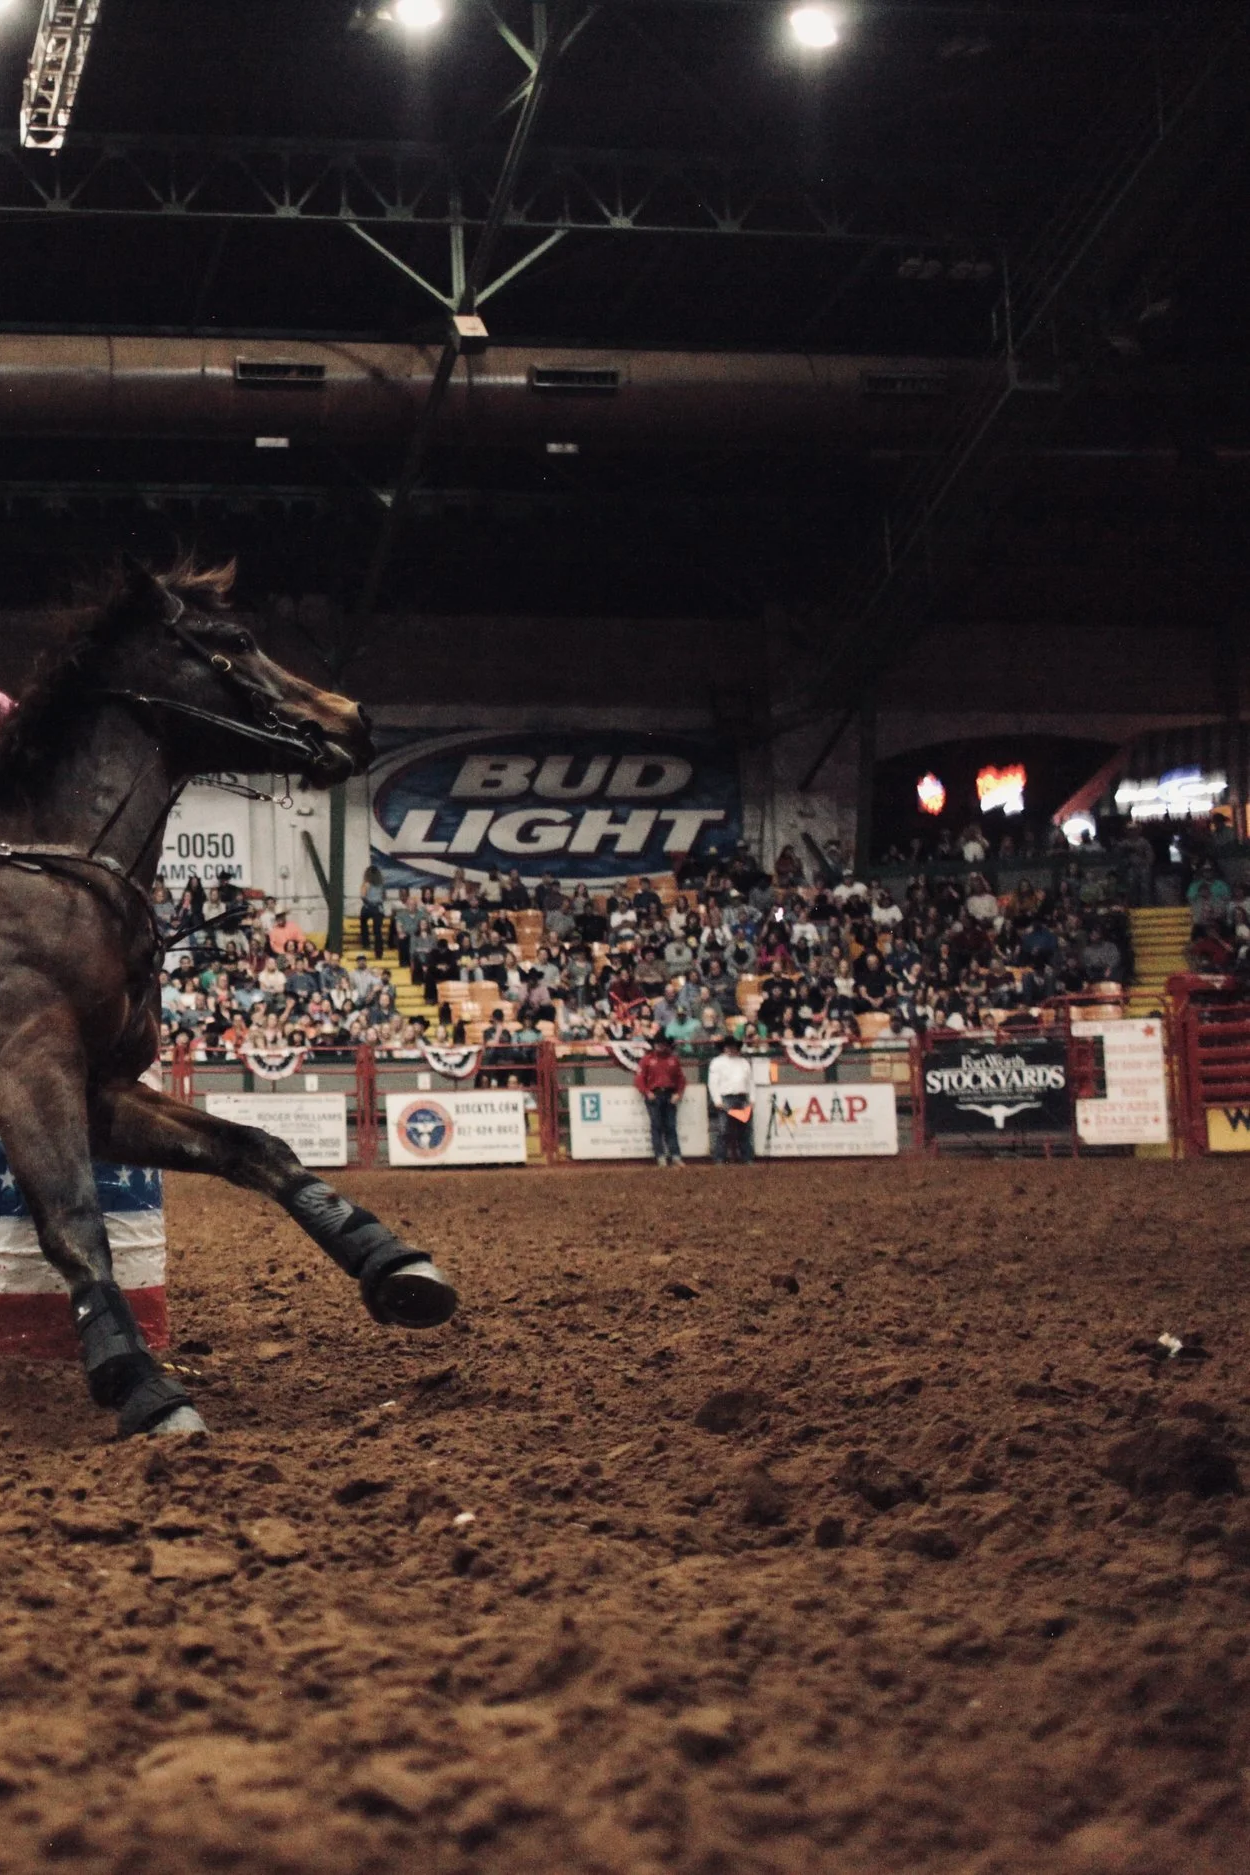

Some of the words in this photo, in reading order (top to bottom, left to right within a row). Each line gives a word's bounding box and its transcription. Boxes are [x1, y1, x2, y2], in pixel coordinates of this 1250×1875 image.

[451, 754, 693, 797] BUD
[165, 833, 236, 859] -0050
[393, 808, 726, 854] LIGHT
[926, 1066, 1066, 1095] STOCKYARDS
